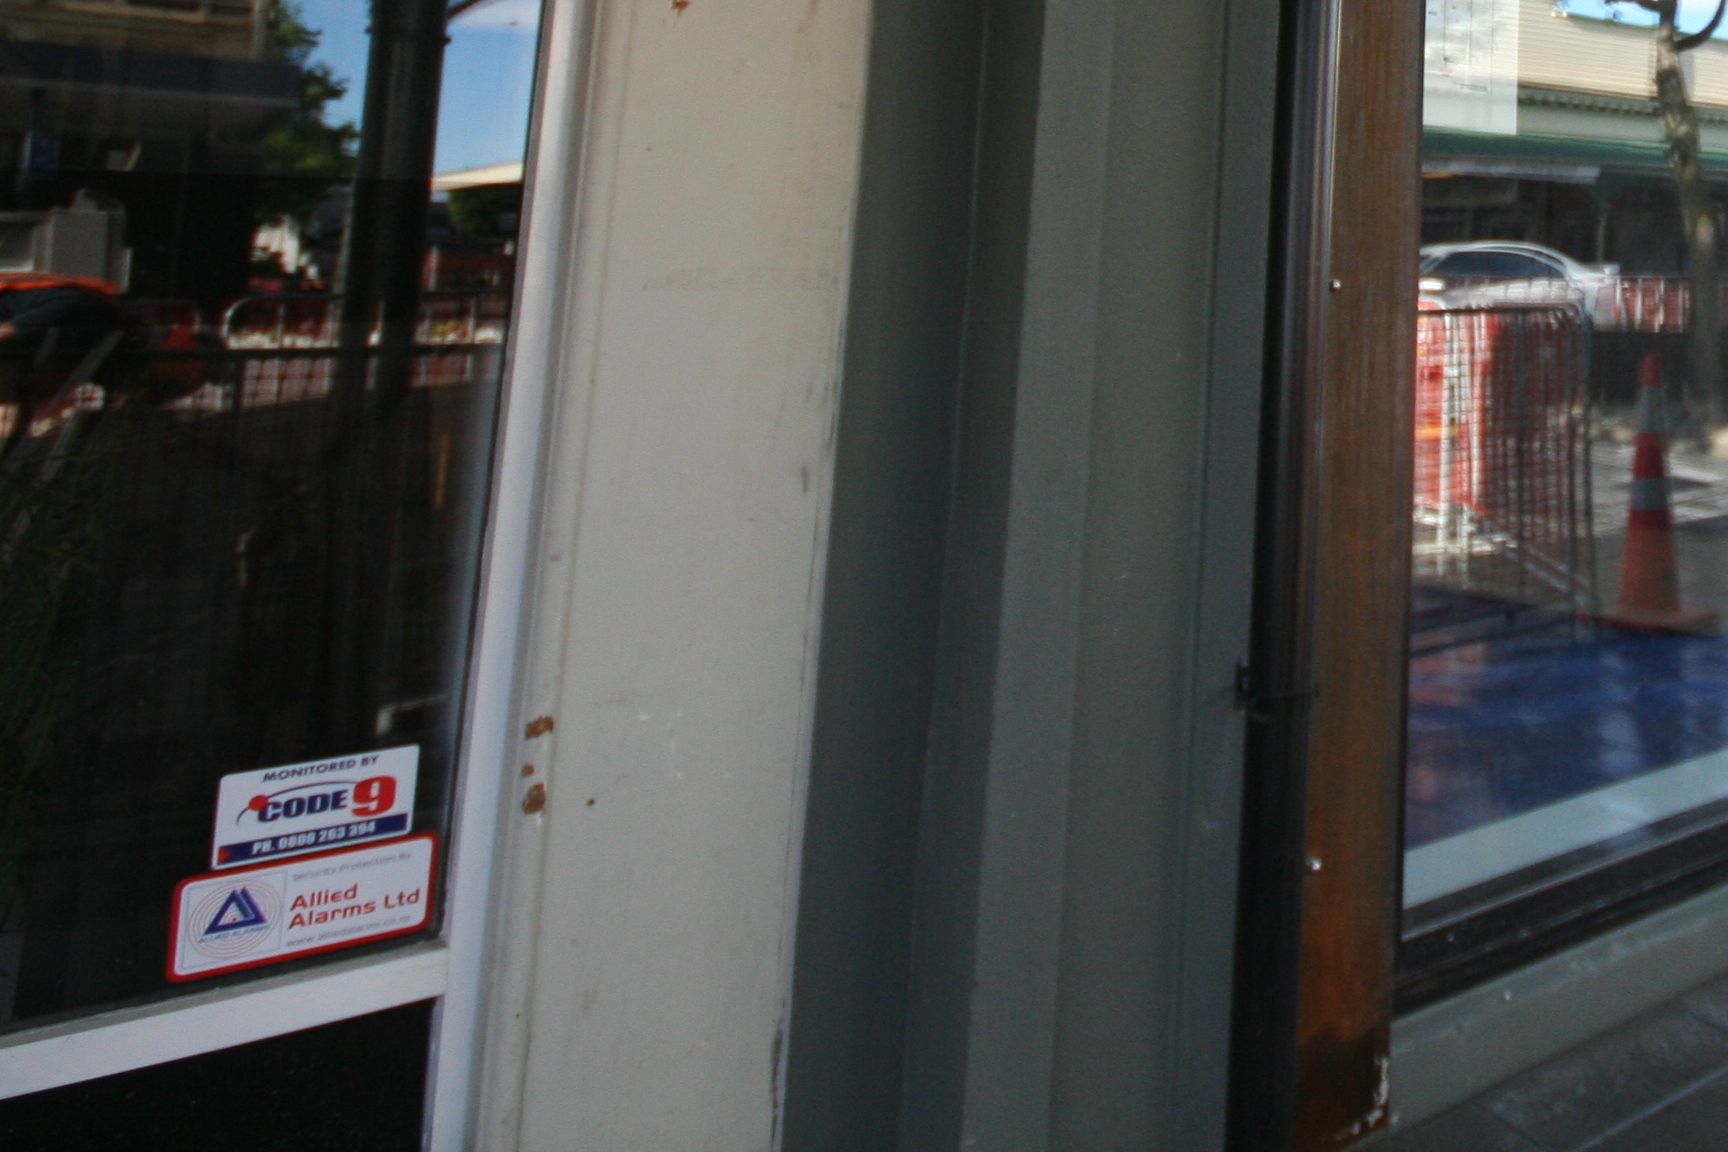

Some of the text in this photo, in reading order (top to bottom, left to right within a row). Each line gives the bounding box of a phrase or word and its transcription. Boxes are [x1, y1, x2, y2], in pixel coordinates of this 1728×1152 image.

[262, 754, 380, 783] MONITORED BY
[288, 887, 421, 929] Alarms Ltd
[290, 883, 358, 912] Allied
